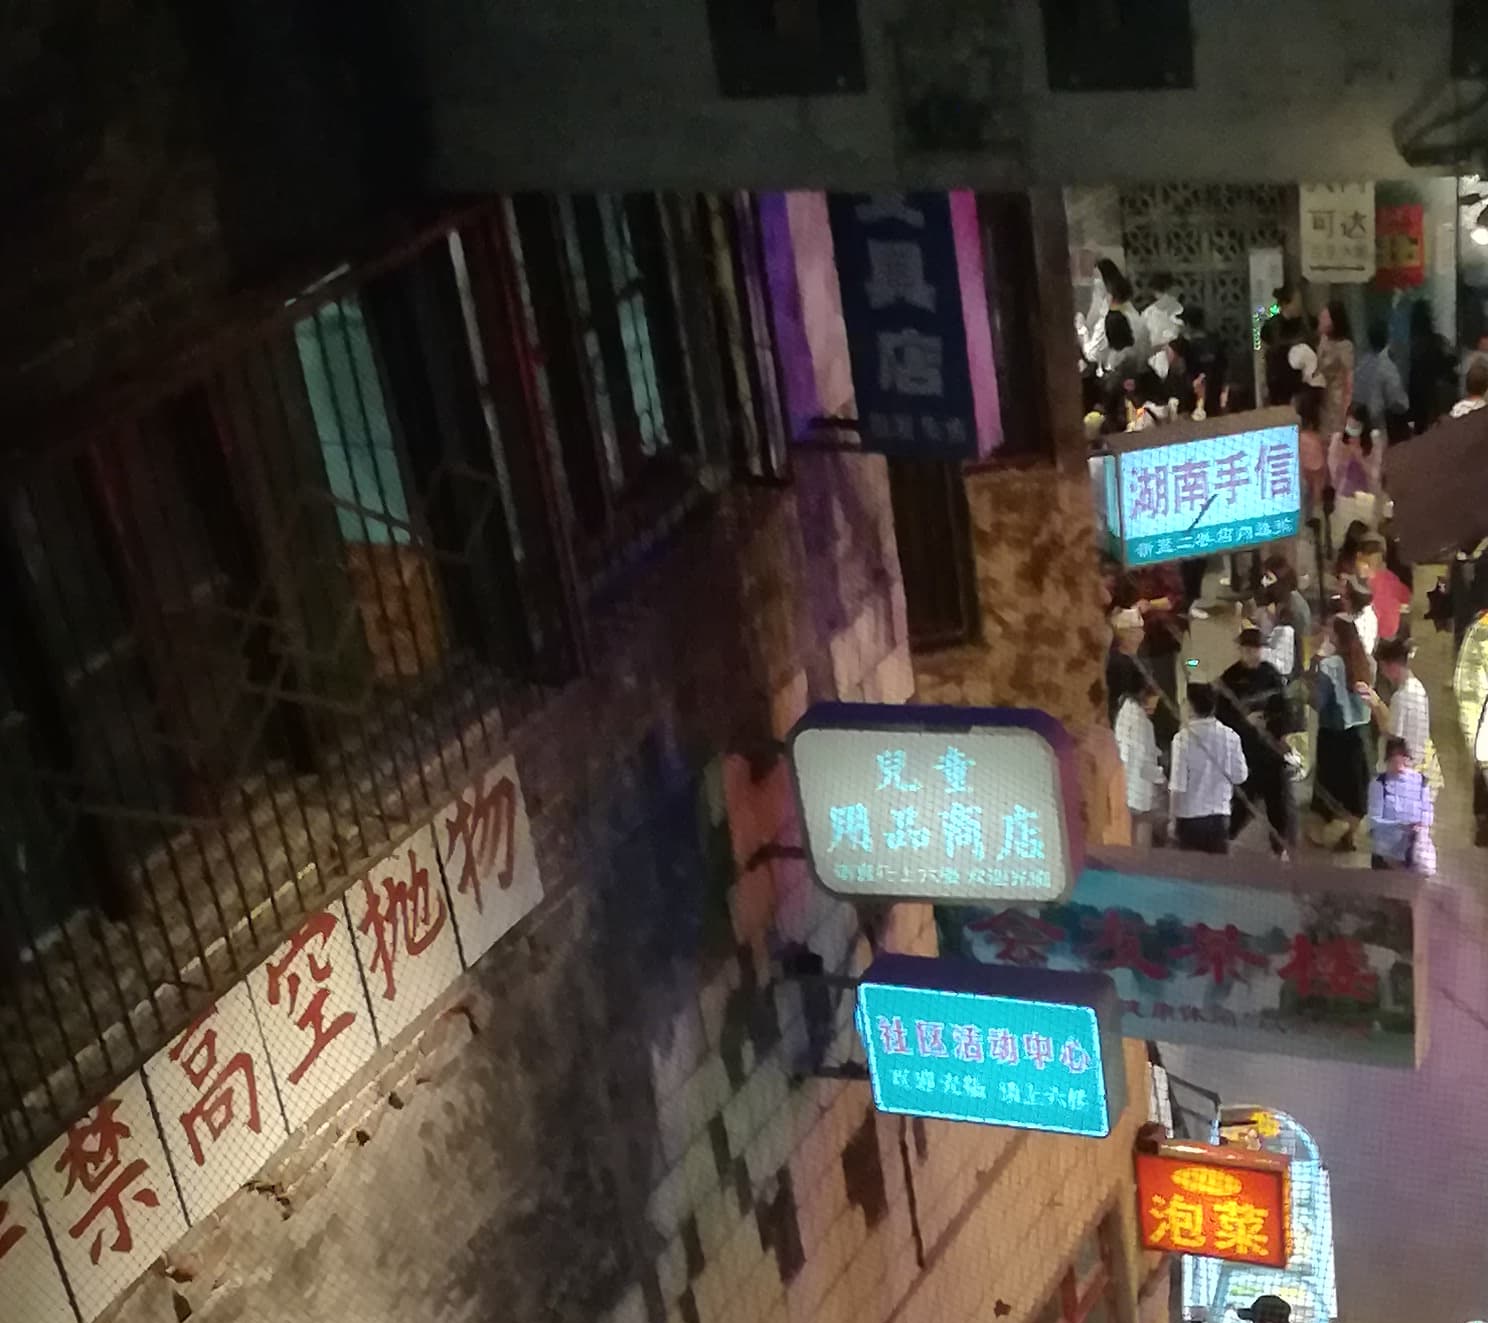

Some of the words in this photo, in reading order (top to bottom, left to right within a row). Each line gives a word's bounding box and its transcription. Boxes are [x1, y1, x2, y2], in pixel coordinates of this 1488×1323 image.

[1130, 443, 1294, 520] 湖南手信
[875, 746, 976, 797] 兒童
[825, 801, 1046, 864] 用品商店
[0, 774, 518, 1264] 禁高空抛物
[876, 1013, 1092, 1074] 社区活动中心
[1149, 1193, 1270, 1257] 泡菜
